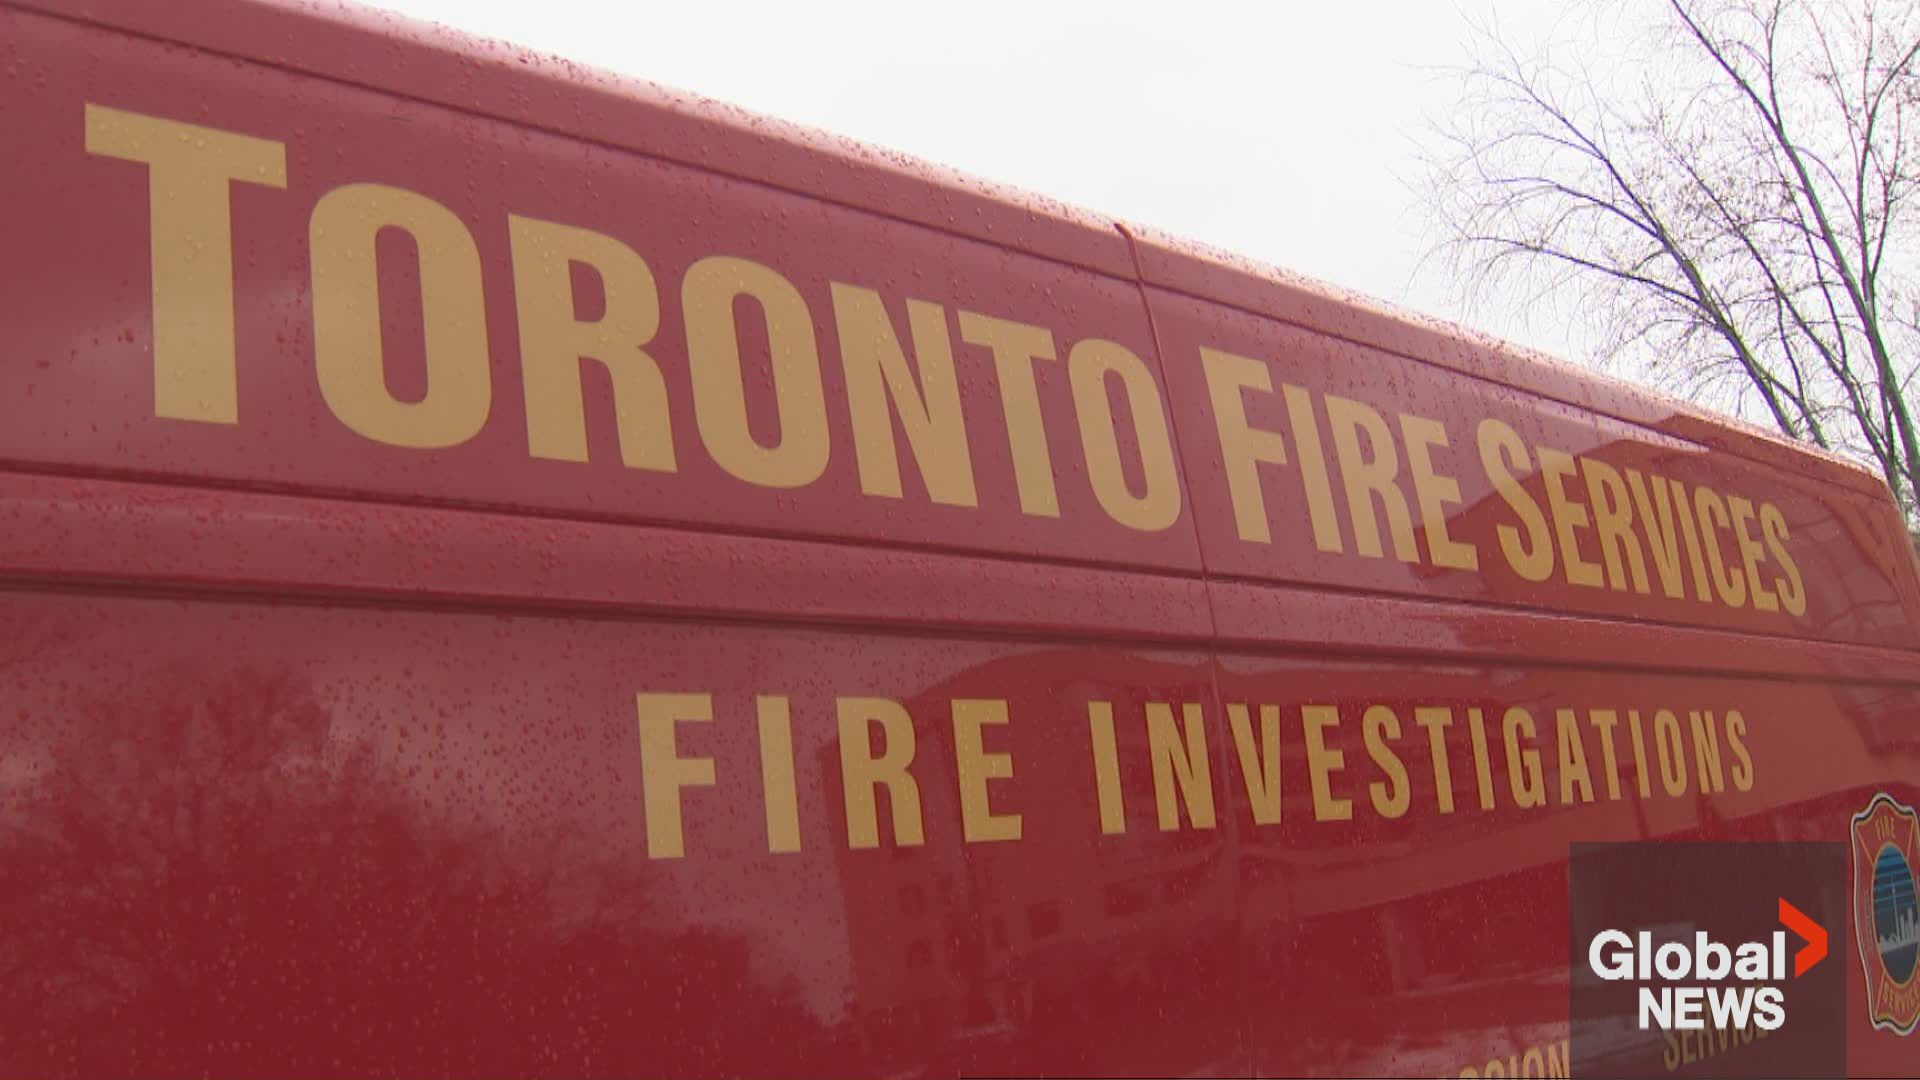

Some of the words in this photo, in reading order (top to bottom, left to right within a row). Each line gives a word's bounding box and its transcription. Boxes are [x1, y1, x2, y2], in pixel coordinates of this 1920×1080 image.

[84, 103, 1182, 531] TORONTO
[1199, 346, 1479, 571] FIRE
[1477, 419, 1807, 617] SERVICES
[637, 692, 1023, 859] FIRE
[1087, 700, 1754, 834] INVESTIGATIONS
